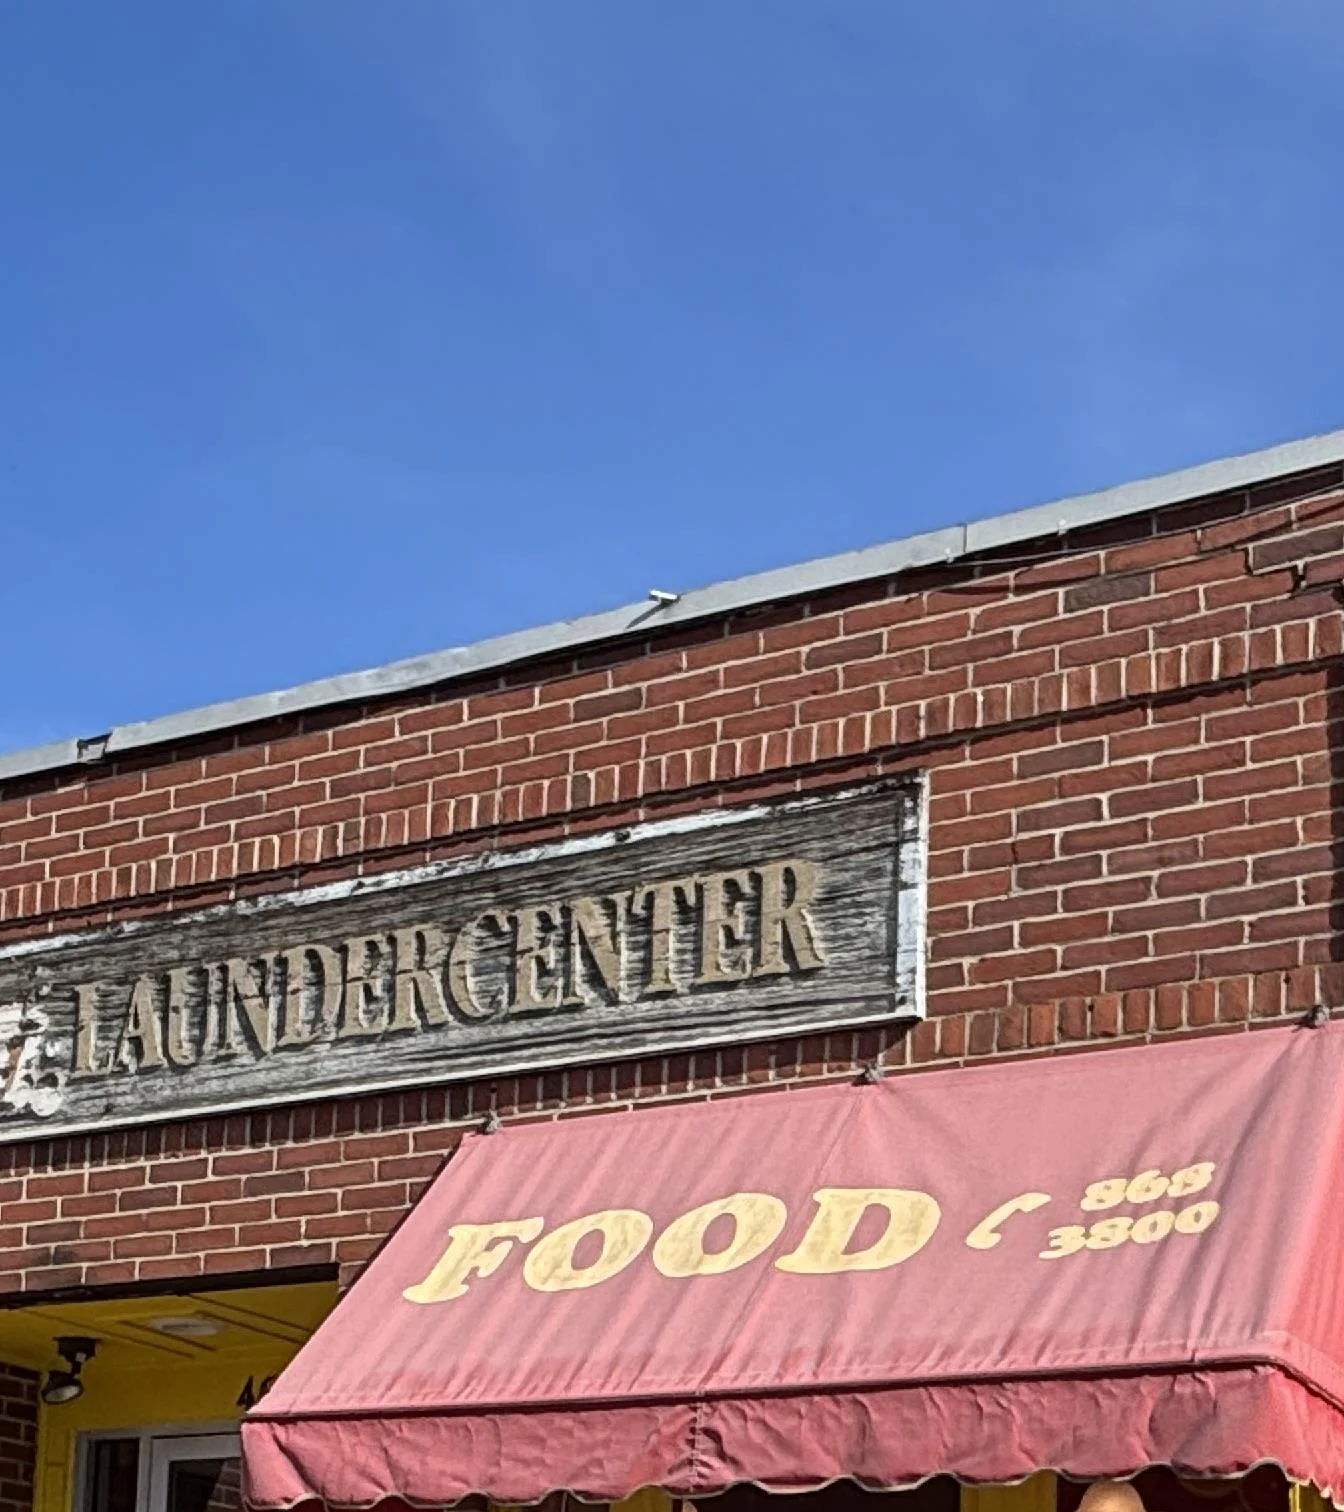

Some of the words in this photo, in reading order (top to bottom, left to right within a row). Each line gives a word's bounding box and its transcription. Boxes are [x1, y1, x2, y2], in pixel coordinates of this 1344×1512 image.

[1080, 1161, 1216, 1212] 868
[401, 1187, 942, 1304] FOOD
[1038, 1200, 1220, 1260] 3800
